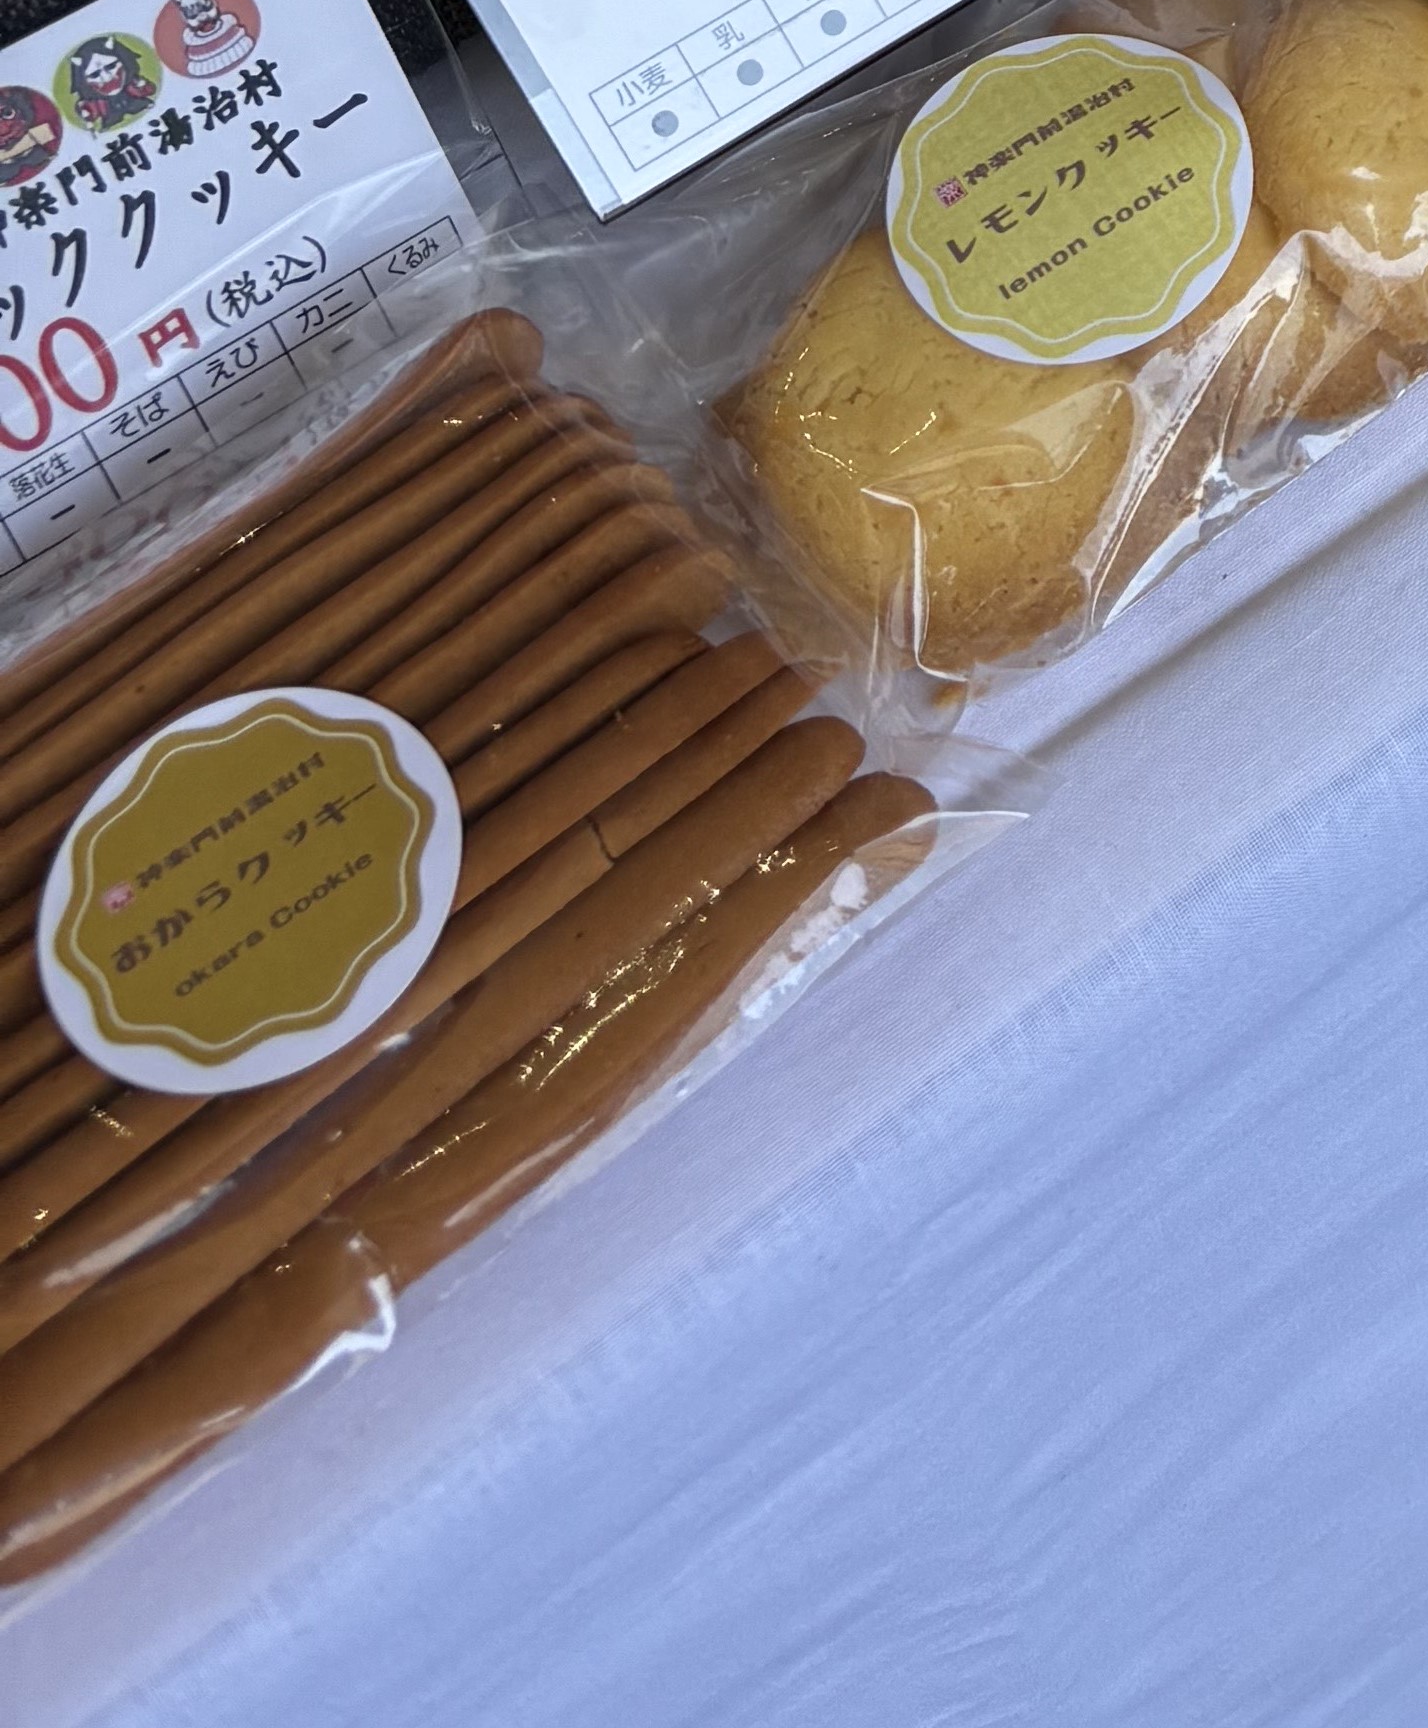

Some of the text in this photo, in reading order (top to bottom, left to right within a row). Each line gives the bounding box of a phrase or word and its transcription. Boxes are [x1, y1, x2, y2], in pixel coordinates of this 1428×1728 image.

[0, 58, 284, 246] 楽門前湯治村
[614, 62, 671, 112] 小麦
[945, 105, 1183, 265] レモンクッキー
[998, 164, 1197, 301] lemon Cookie
[108, 390, 171, 440] そば
[205, 335, 262, 389] えび
[297, 287, 354, 336] カニ
[110, 783, 378, 976] おからクッキー
[173, 852, 375, 999] okara Cookie
